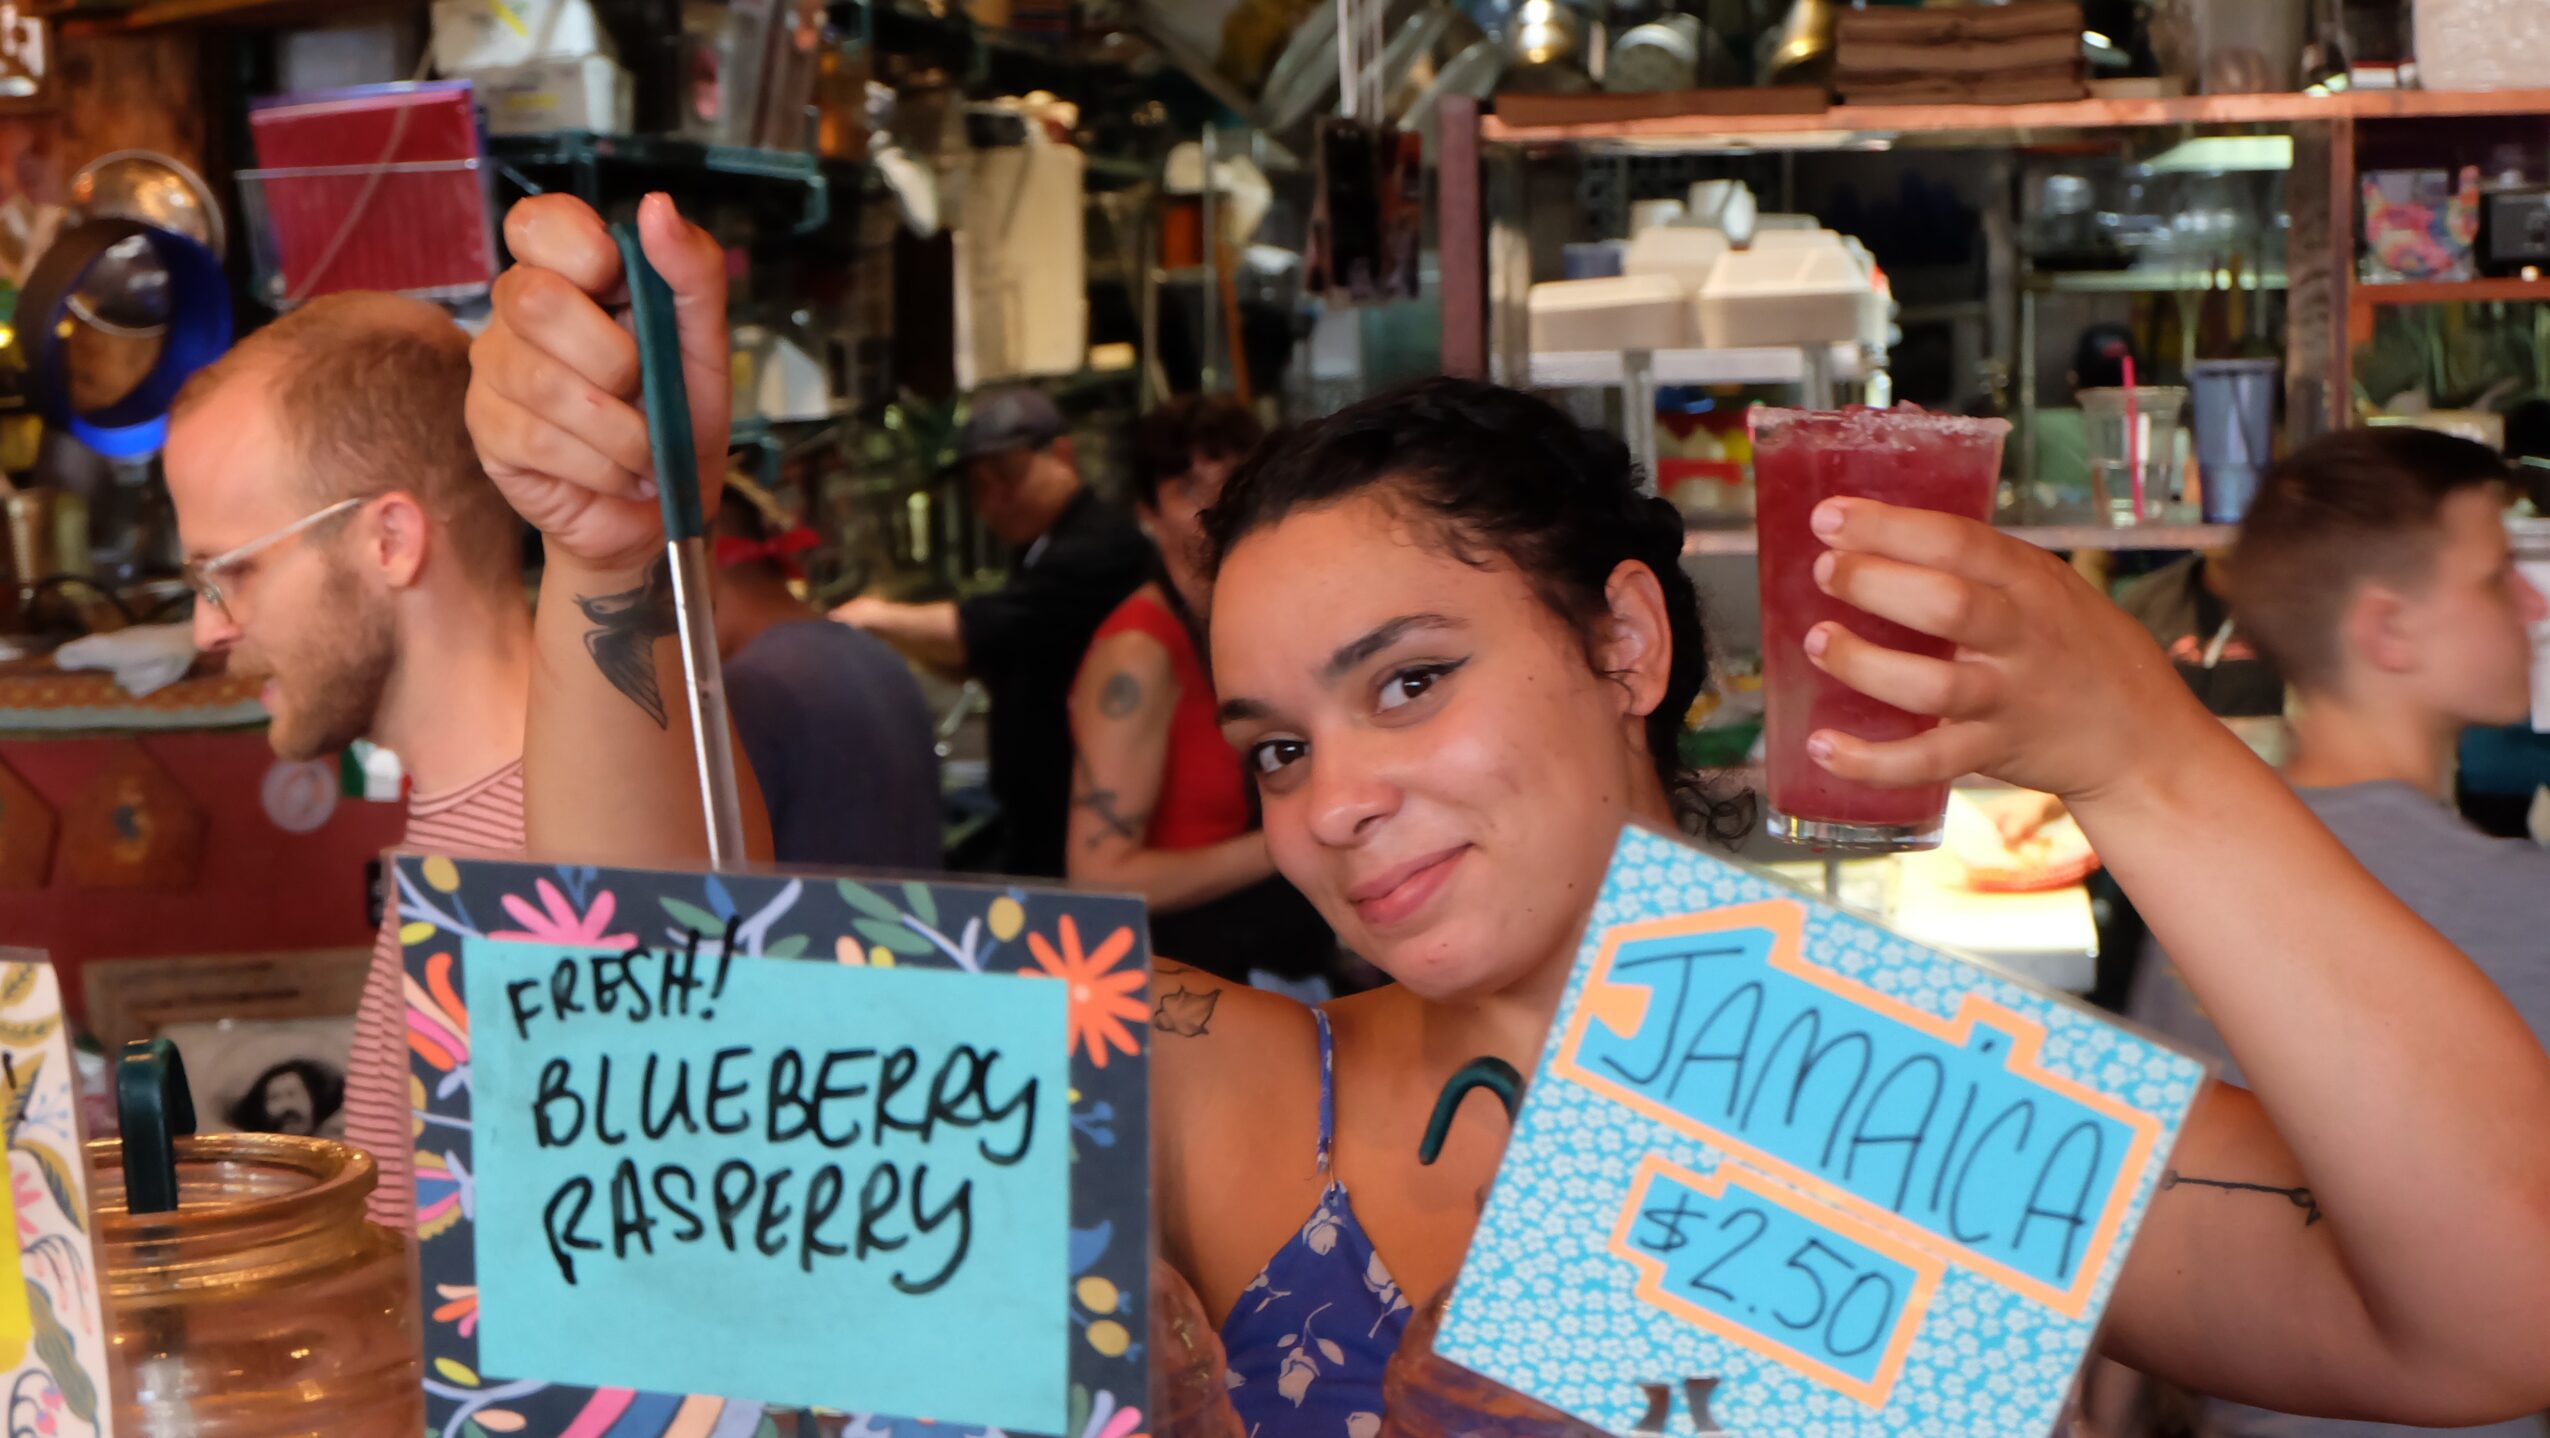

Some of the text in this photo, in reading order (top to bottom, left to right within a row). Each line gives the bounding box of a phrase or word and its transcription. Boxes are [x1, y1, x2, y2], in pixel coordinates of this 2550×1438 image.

[507, 916, 742, 1039] FRESH!
[533, 1045, 1039, 1165] BLUEBERRY
[543, 1158, 973, 1295] RASPERRY
[1639, 1193, 1896, 1357] $2.50
